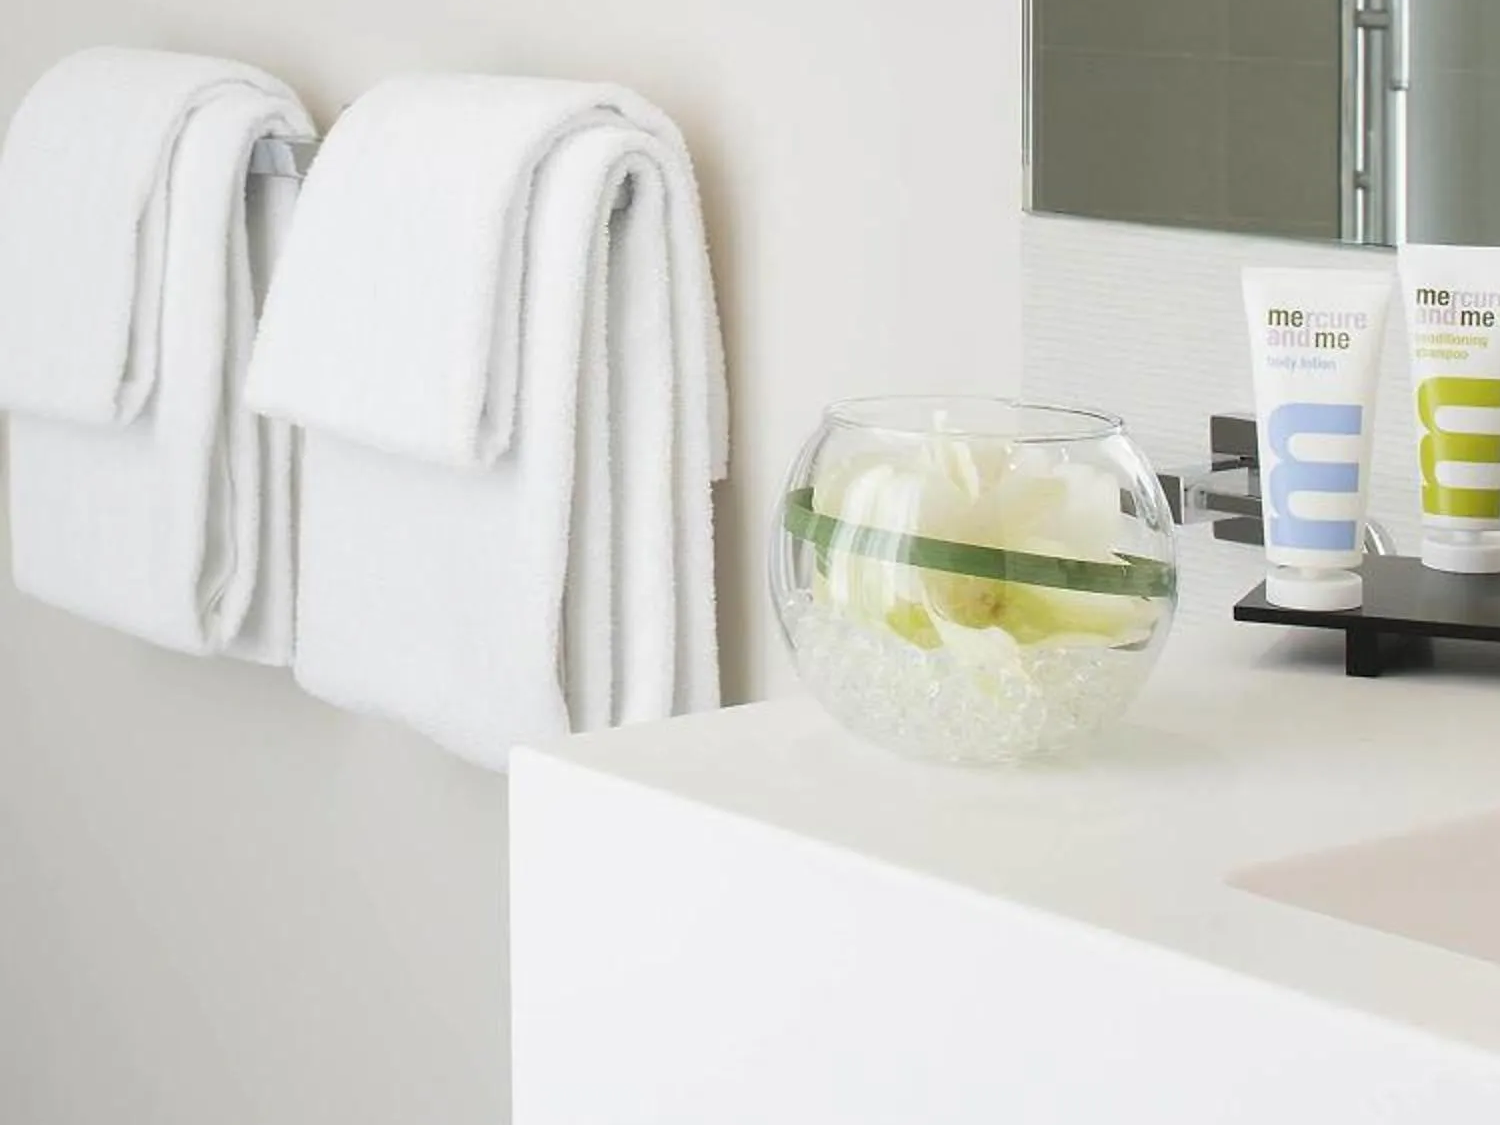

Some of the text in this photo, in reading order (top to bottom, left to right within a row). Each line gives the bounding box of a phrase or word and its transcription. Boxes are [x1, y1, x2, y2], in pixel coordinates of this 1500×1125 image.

[1268, 308, 1367, 329] mercure
[1416, 302, 1495, 327] and me
[1267, 324, 1351, 349] and me
